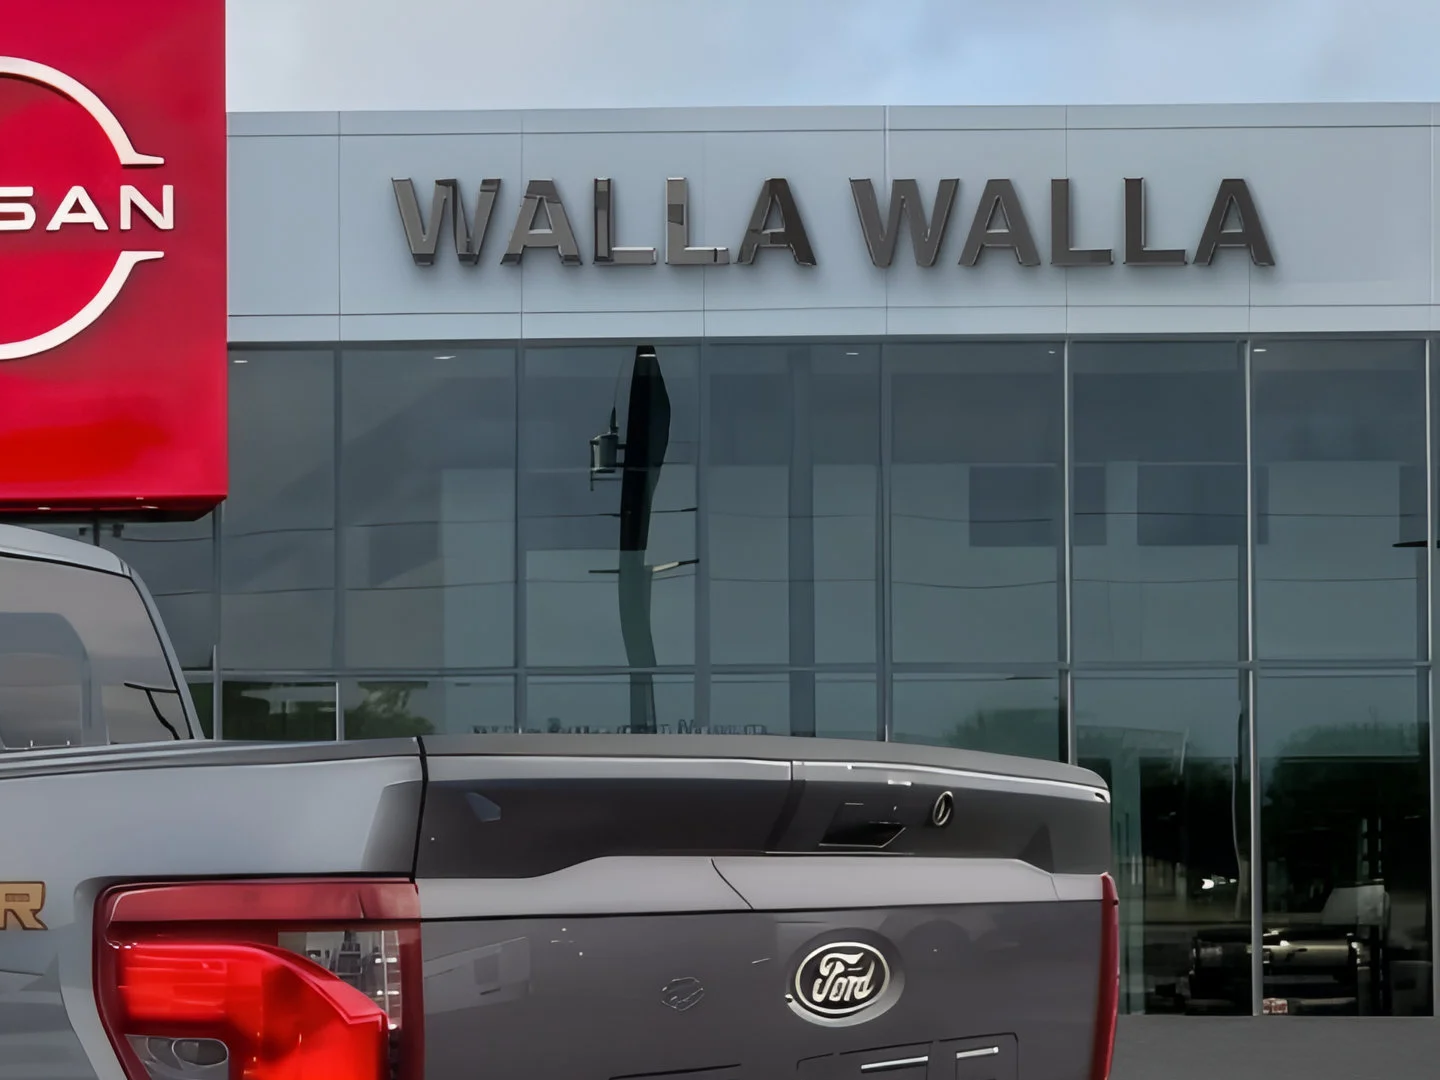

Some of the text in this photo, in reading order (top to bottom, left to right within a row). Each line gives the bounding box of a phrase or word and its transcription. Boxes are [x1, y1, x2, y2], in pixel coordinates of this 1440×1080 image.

[391, 176, 1276, 266] WALLA WALLA
[812, 952, 876, 1003] Ford
